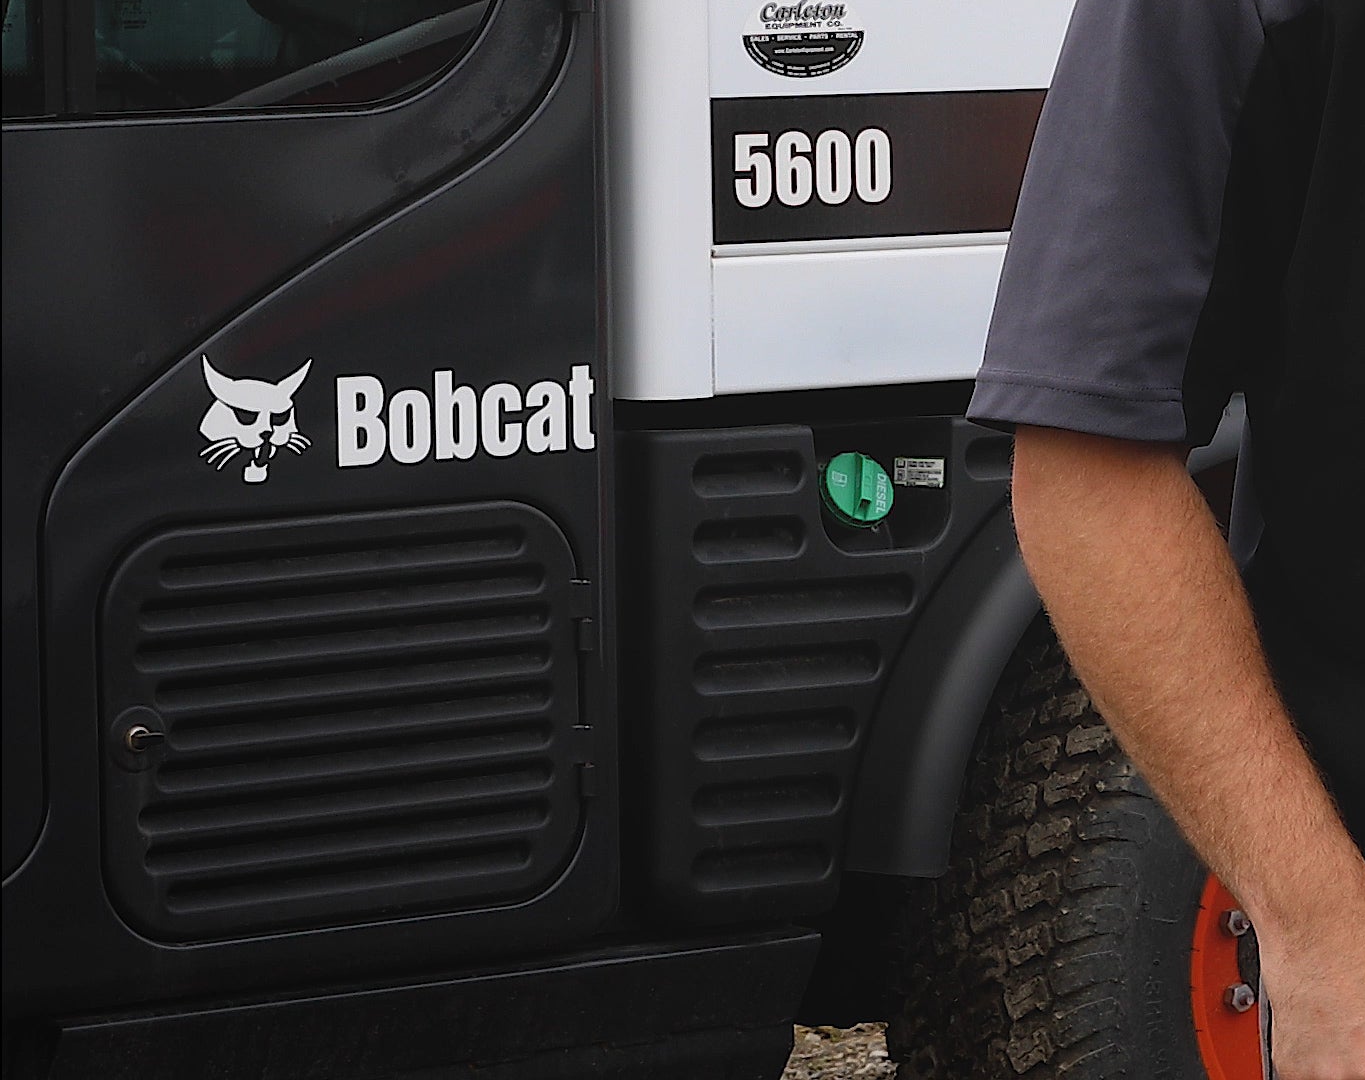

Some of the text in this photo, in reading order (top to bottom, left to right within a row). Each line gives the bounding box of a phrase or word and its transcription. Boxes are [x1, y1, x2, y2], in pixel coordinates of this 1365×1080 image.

[734, 128, 892, 208] 5600
[335, 364, 596, 468] Bobcat
[875, 472, 888, 514] DIESEL
